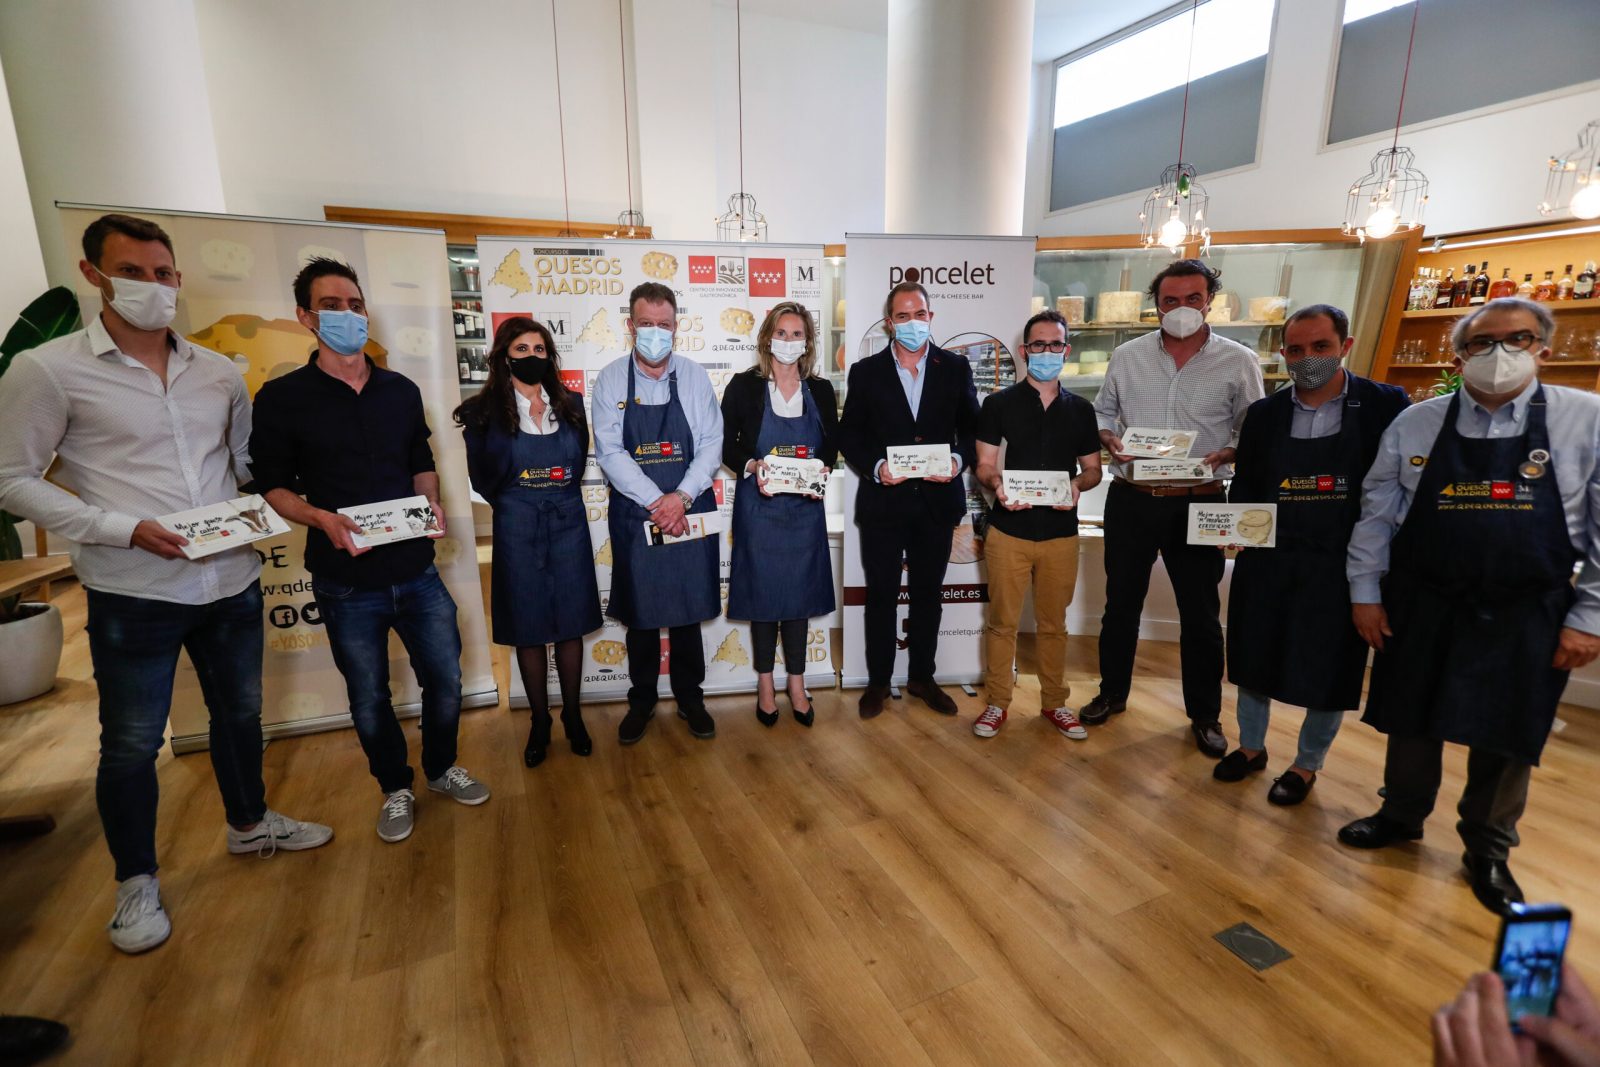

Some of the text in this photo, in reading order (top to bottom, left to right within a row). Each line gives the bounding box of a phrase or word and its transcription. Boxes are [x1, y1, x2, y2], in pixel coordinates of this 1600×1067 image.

[534, 256, 622, 277] QUESOS
[796, 265, 815, 281] M
[889, 261, 995, 290] poncelet
[536, 277, 624, 295] MADRID
